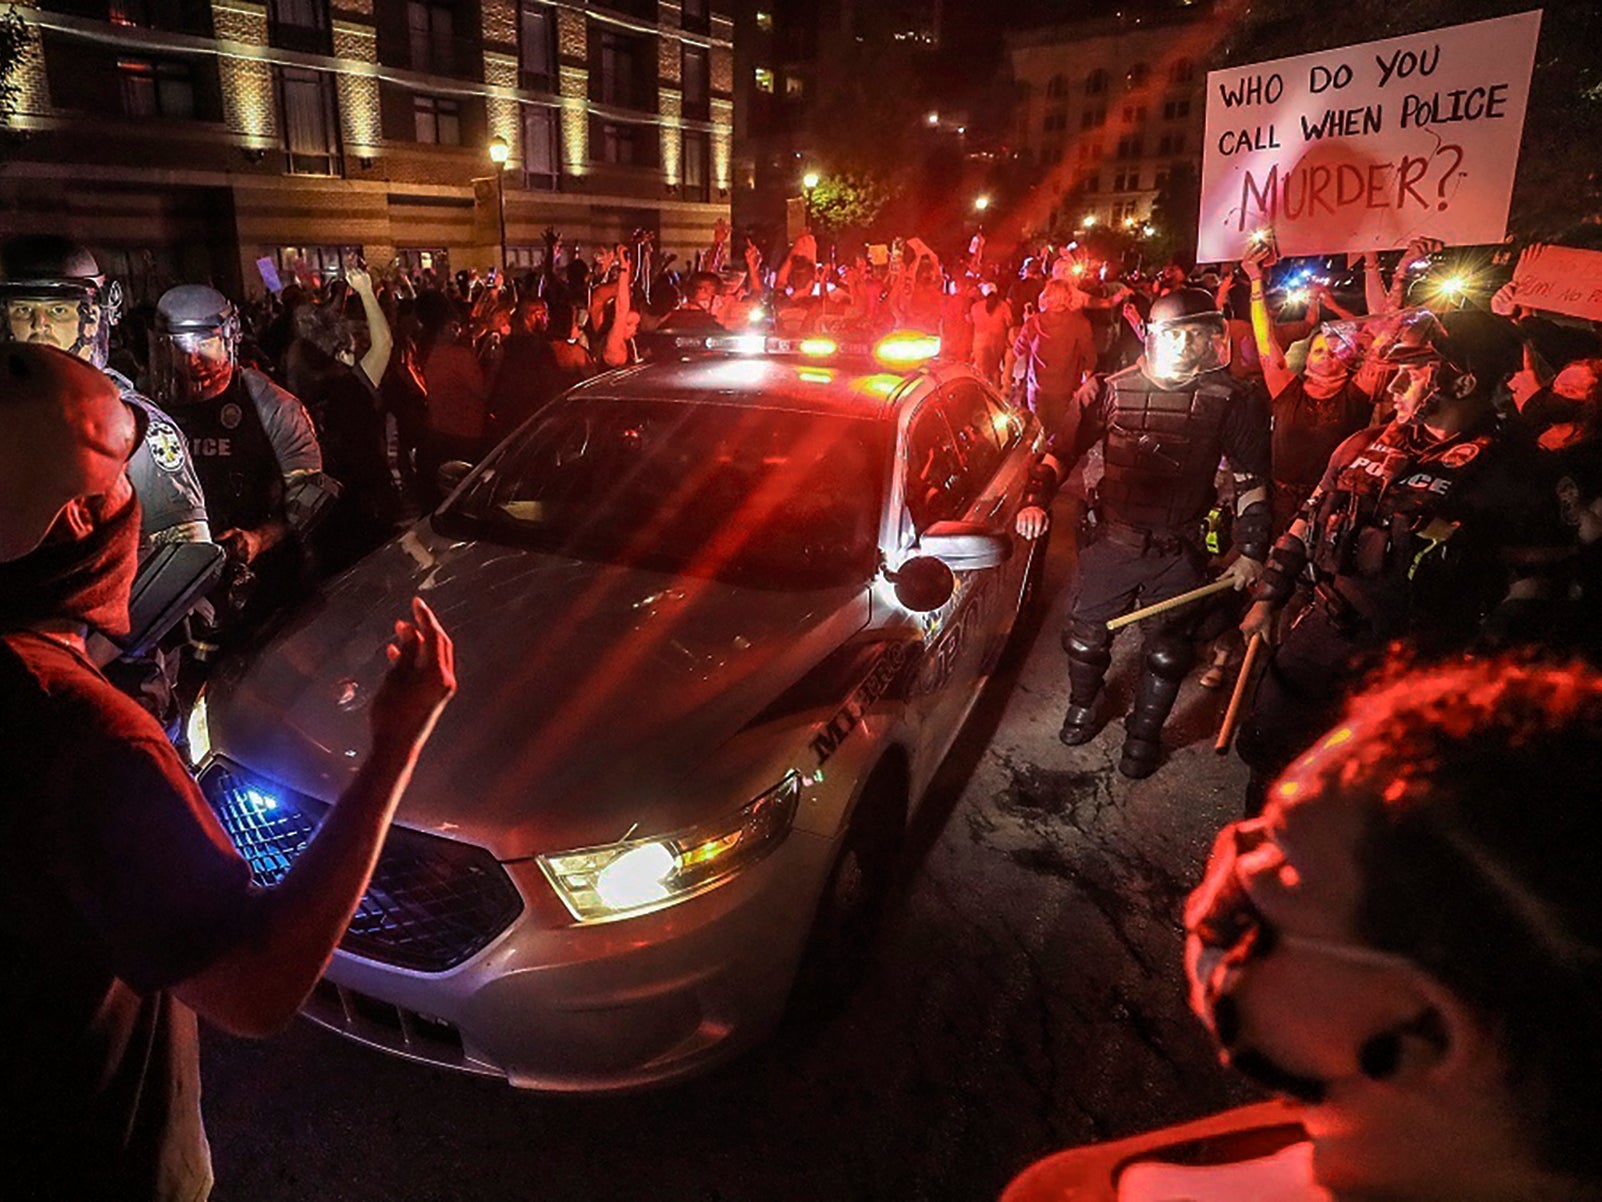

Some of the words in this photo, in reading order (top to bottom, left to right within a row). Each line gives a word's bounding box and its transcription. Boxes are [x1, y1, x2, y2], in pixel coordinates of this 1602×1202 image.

[1219, 73, 1283, 108] WHO
[1310, 64, 1353, 93] DO
[1376, 45, 1439, 87] YOU
[1218, 124, 1281, 156] CALL
[1301, 105, 1382, 141] WHEN
[1401, 84, 1508, 128] POLICE
[1238, 145, 1464, 232] MURDER?
[192, 438, 232, 456] ICE
